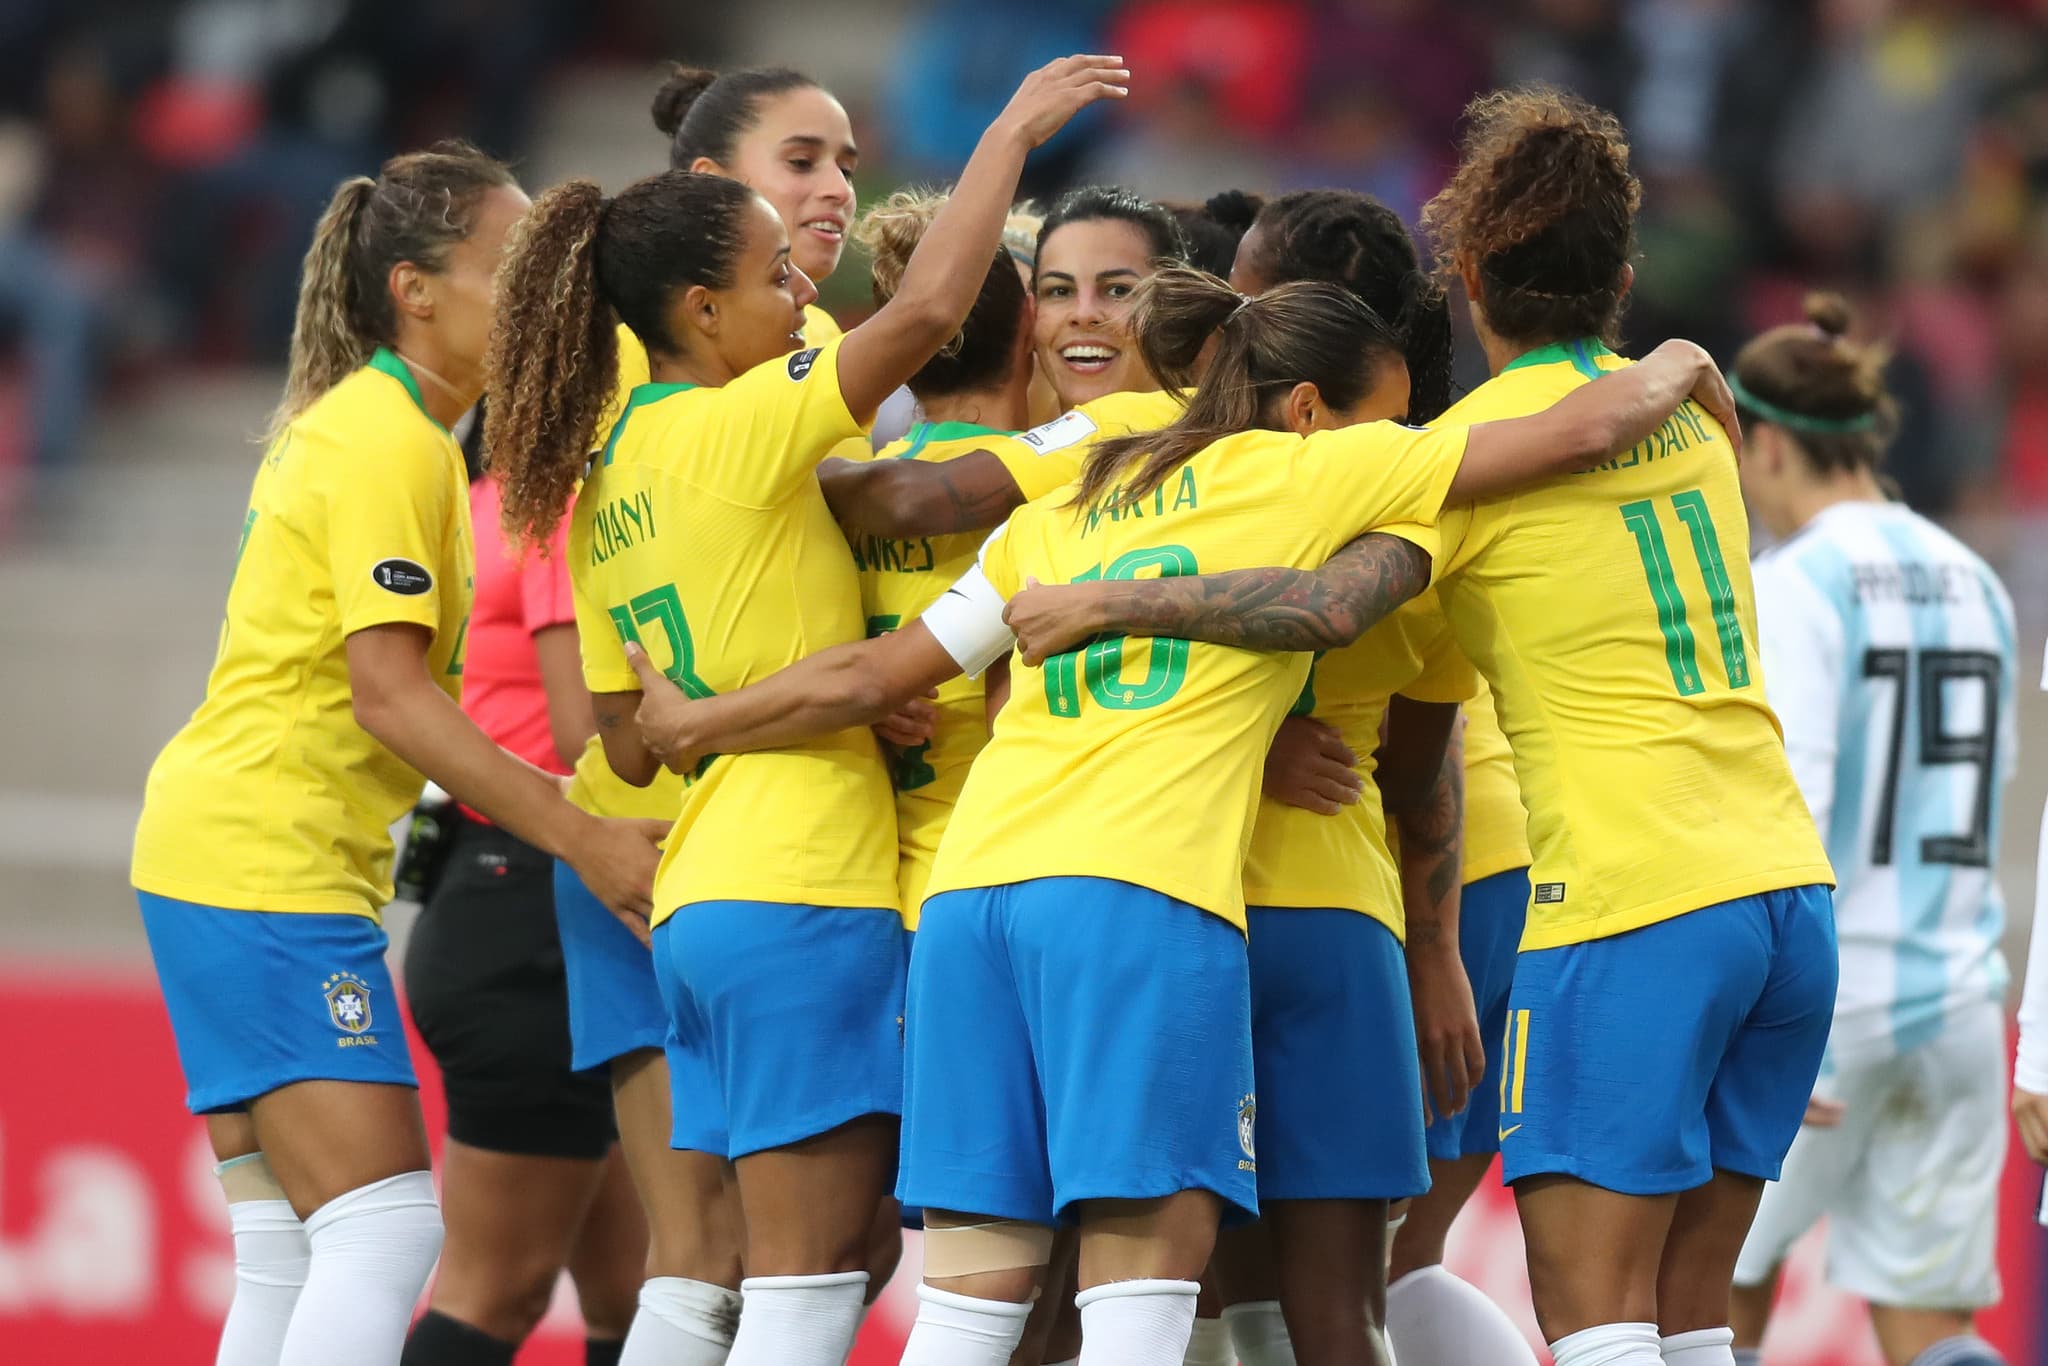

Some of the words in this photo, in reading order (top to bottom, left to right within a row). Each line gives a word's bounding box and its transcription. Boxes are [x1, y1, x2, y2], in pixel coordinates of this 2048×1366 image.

[1043, 544, 1199, 718] 10
[1619, 488, 1751, 697] 11
[1863, 646, 2003, 867] 19
